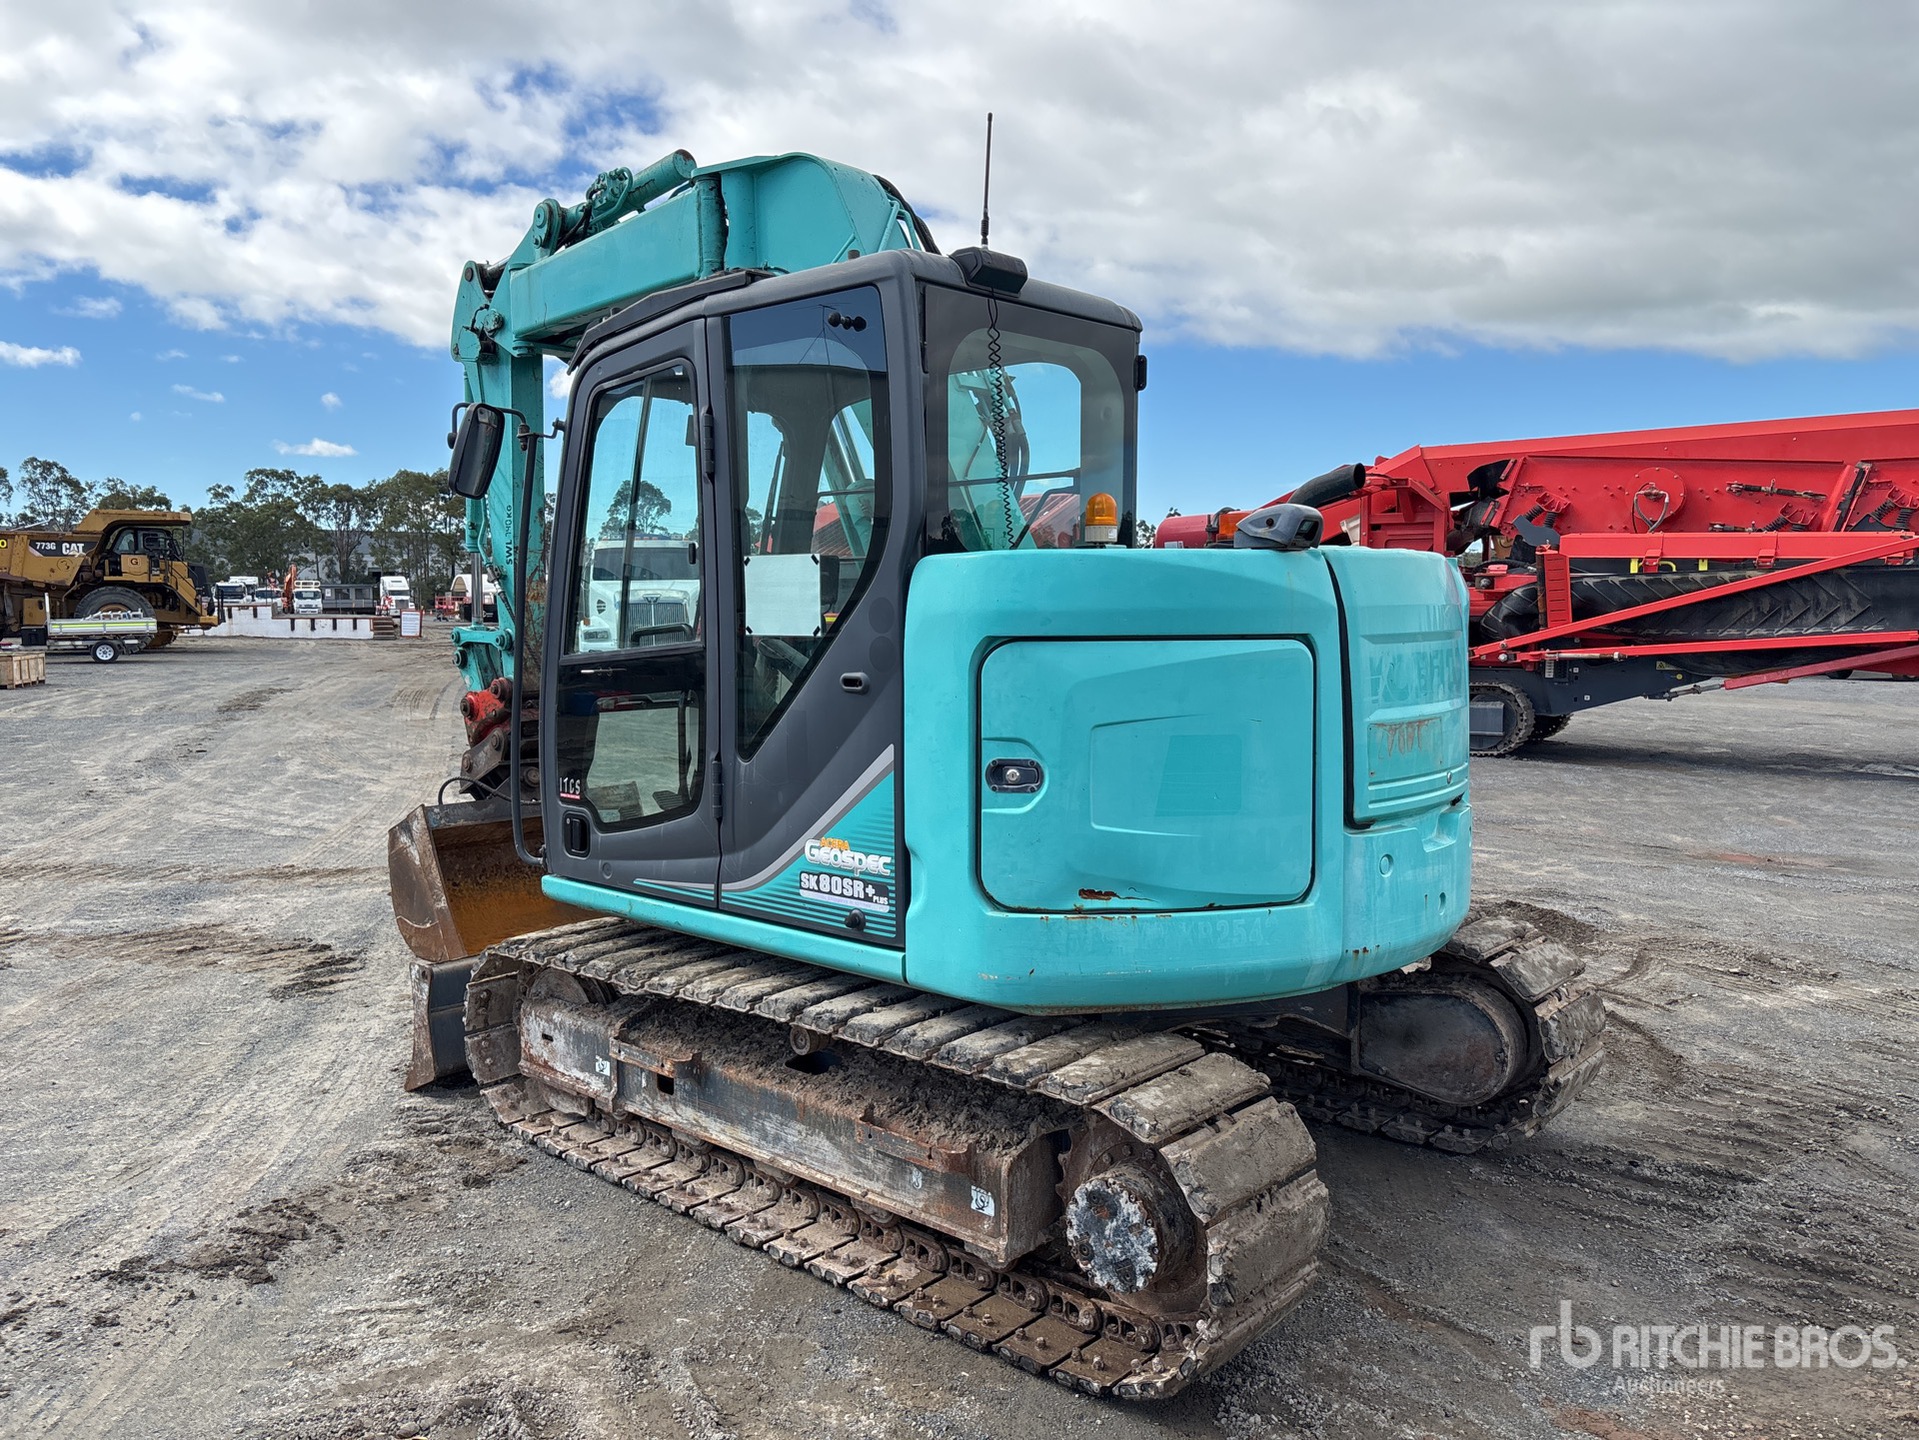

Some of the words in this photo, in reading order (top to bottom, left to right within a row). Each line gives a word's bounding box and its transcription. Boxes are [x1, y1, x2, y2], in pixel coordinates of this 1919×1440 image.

[35, 542, 56, 550] 773G
[62, 542, 84, 555] CAT
[506, 539, 514, 565] SWL
